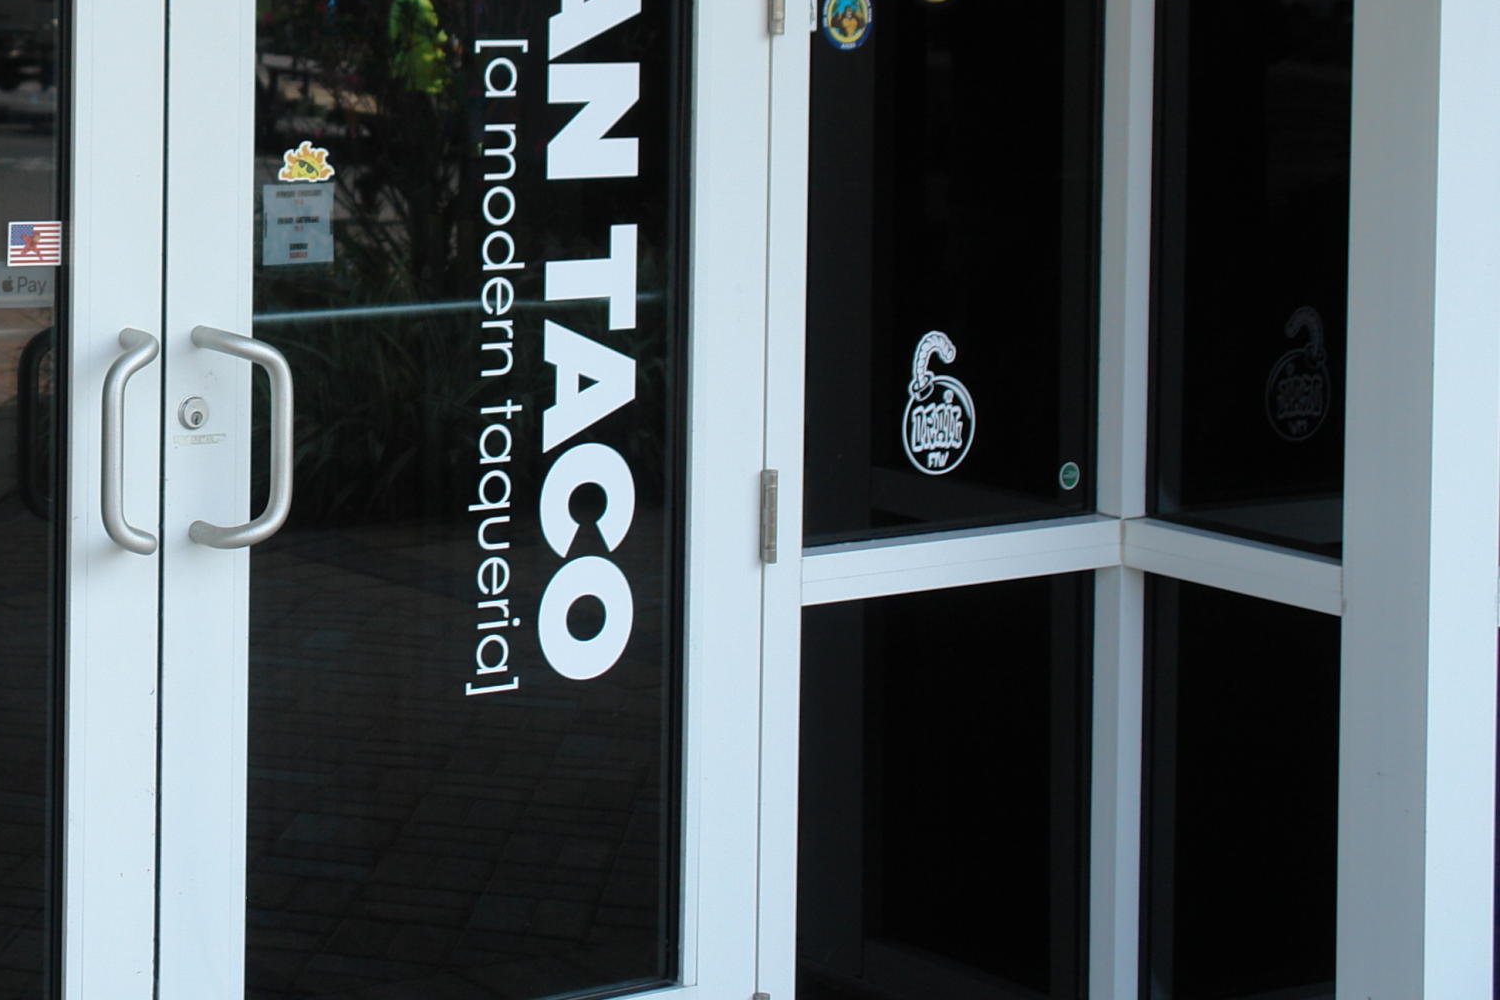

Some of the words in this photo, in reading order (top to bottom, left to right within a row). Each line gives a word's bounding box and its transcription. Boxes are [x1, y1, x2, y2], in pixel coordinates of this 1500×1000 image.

[16, 275, 48, 296] Pay
[481, 123, 524, 377] modern
[465, 399, 523, 696] taqueria]
[538, 223, 638, 680] TACO
